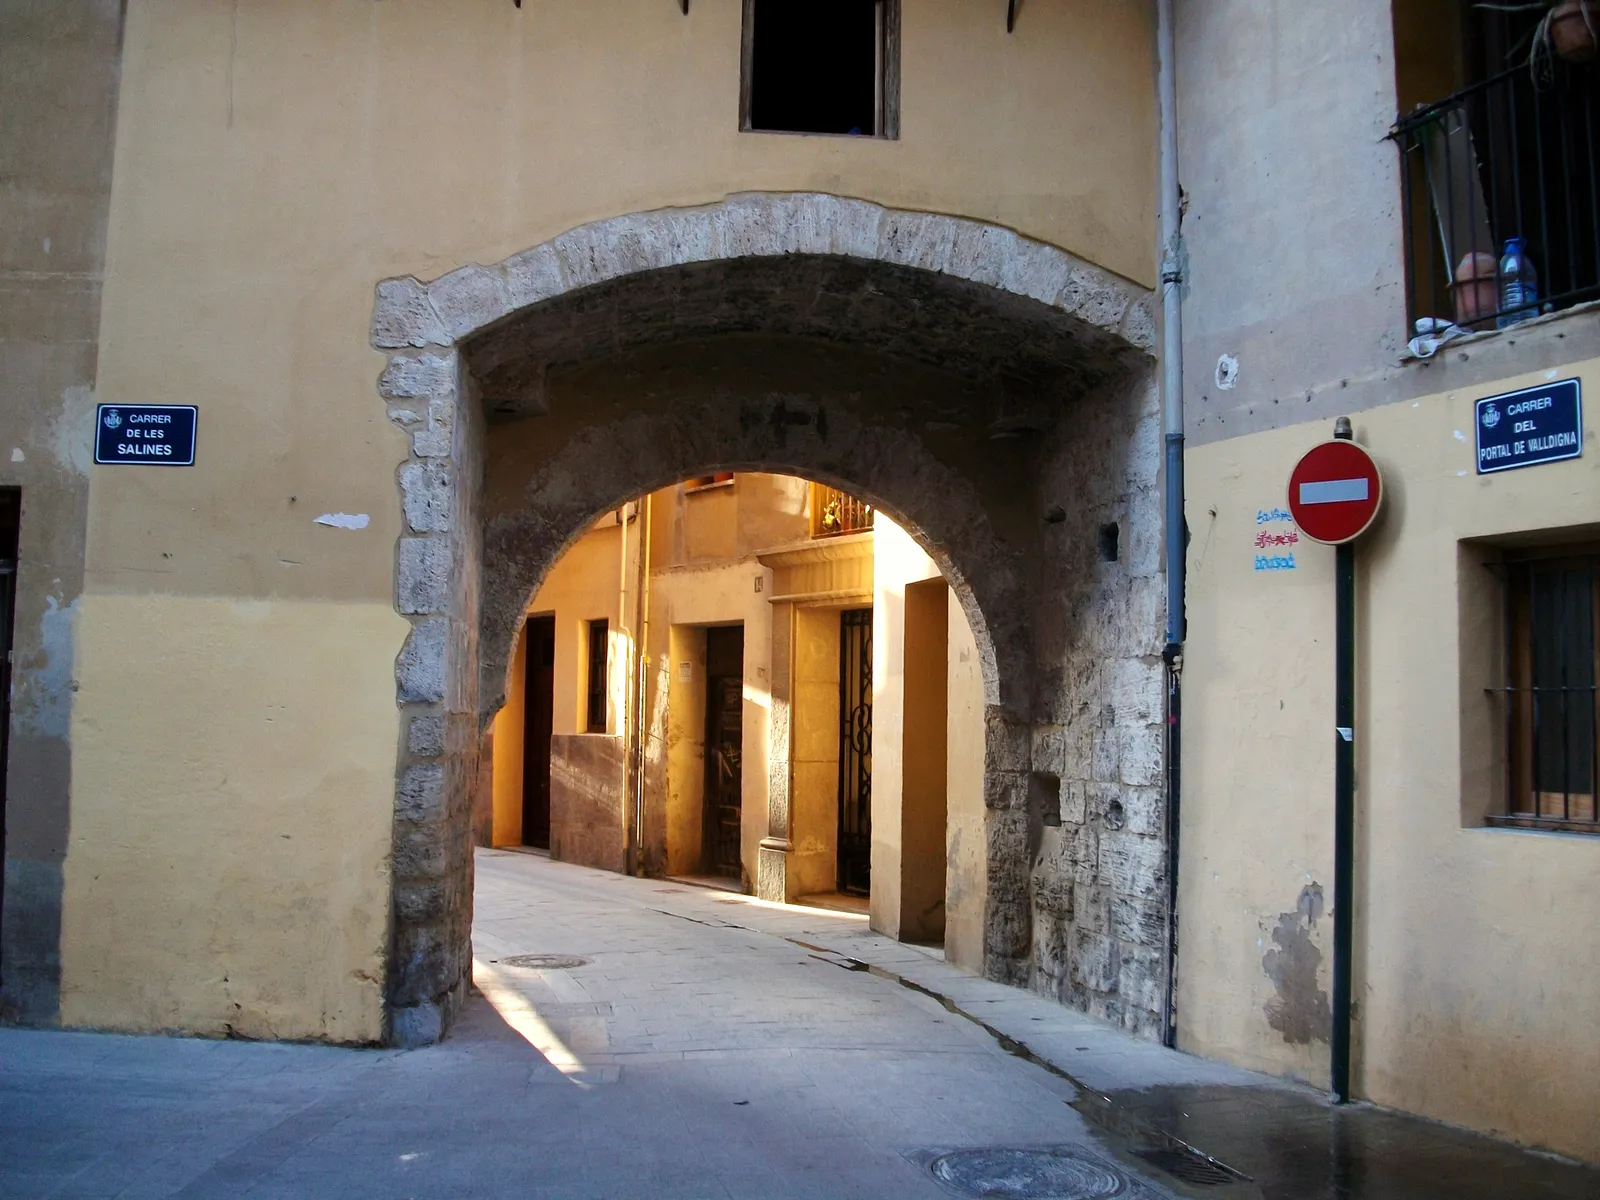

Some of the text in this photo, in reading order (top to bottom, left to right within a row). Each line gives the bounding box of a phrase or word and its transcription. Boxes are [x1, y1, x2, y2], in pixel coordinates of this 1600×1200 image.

[1507, 397, 1552, 416] CARRER
[129, 414, 172, 424] CARRER
[1514, 420, 1537, 433] DEL
[126, 429, 165, 439] DE LES
[117, 443, 172, 456] SALINES
[1480, 431, 1577, 461] PORTAL DE VALLDIGNA
